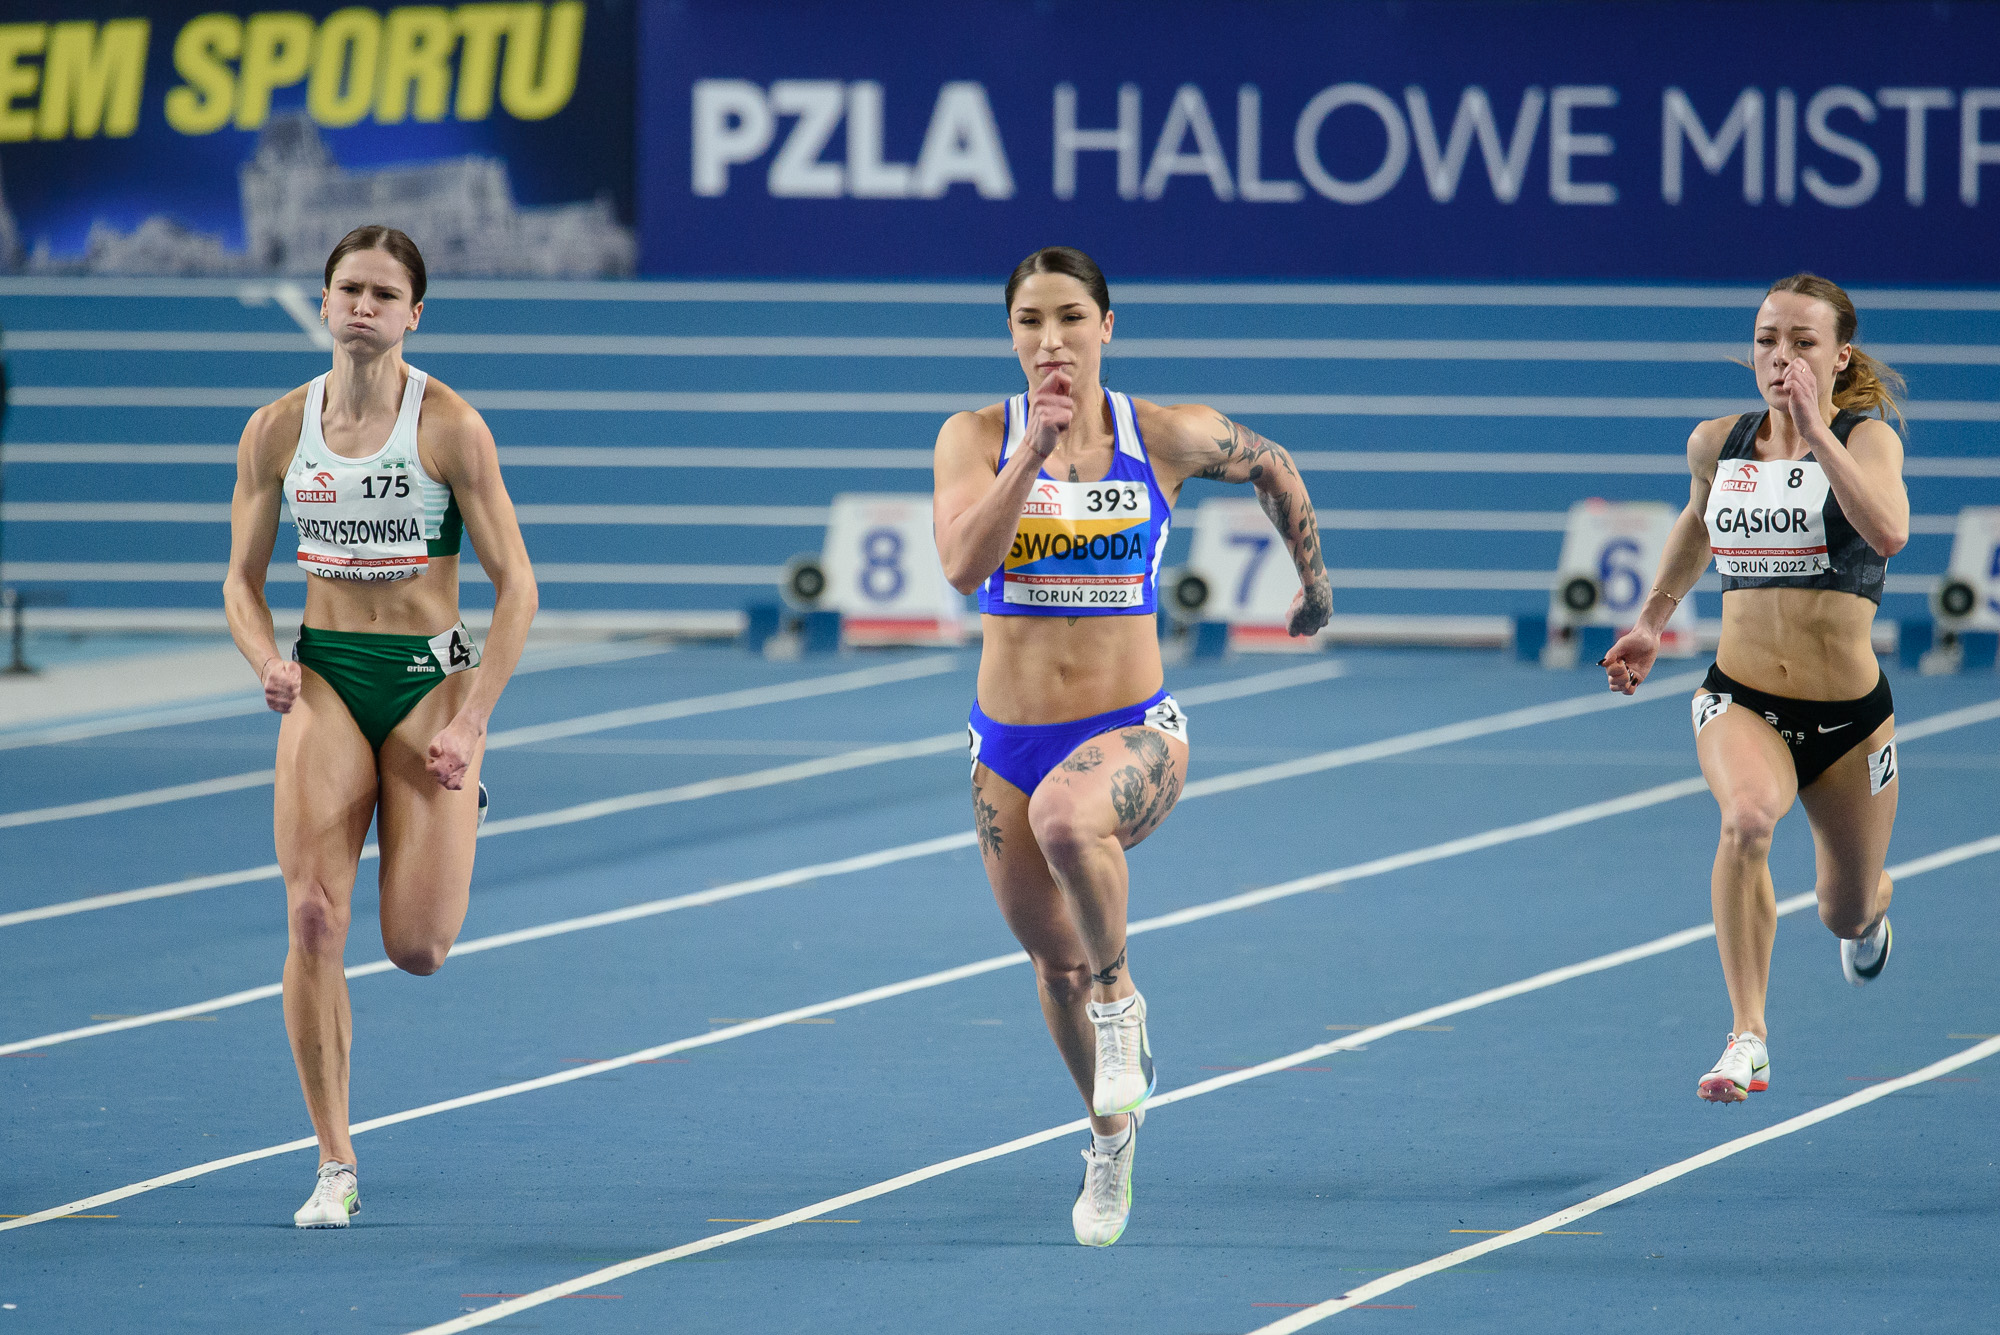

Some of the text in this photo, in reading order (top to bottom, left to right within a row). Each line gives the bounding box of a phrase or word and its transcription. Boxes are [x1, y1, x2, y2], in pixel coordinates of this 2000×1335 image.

[0, 2, 587, 142] EM SPORTU
[691, 79, 1015, 198] PZLA
[1052, 82, 1618, 205] HALOWE
[361, 474, 410, 498] 175
[1722, 481, 1755, 491] ORLEN
[1787, 467, 1804, 488] 8
[298, 491, 334, 502] ORLEN
[1023, 503, 1060, 514] ORLEN
[1086, 488, 1138, 513] 393
[297, 516, 421, 546] SKRZYSZOWSKA
[1715, 507, 1810, 539] GĄSIOR
[1010, 532, 1143, 560] SWOBODA
[859, 528, 907, 598] 8
[1227, 533, 1272, 606] 7
[1599, 537, 1643, 611] 6
[1772, 560, 1808, 573] 2022
[367, 571, 405, 582] 2022
[1027, 586, 1127, 603] TORUŃ 2022
[449, 630, 471, 667] 4
[407, 665, 436, 673] erima
[1879, 744, 1895, 788] 2
